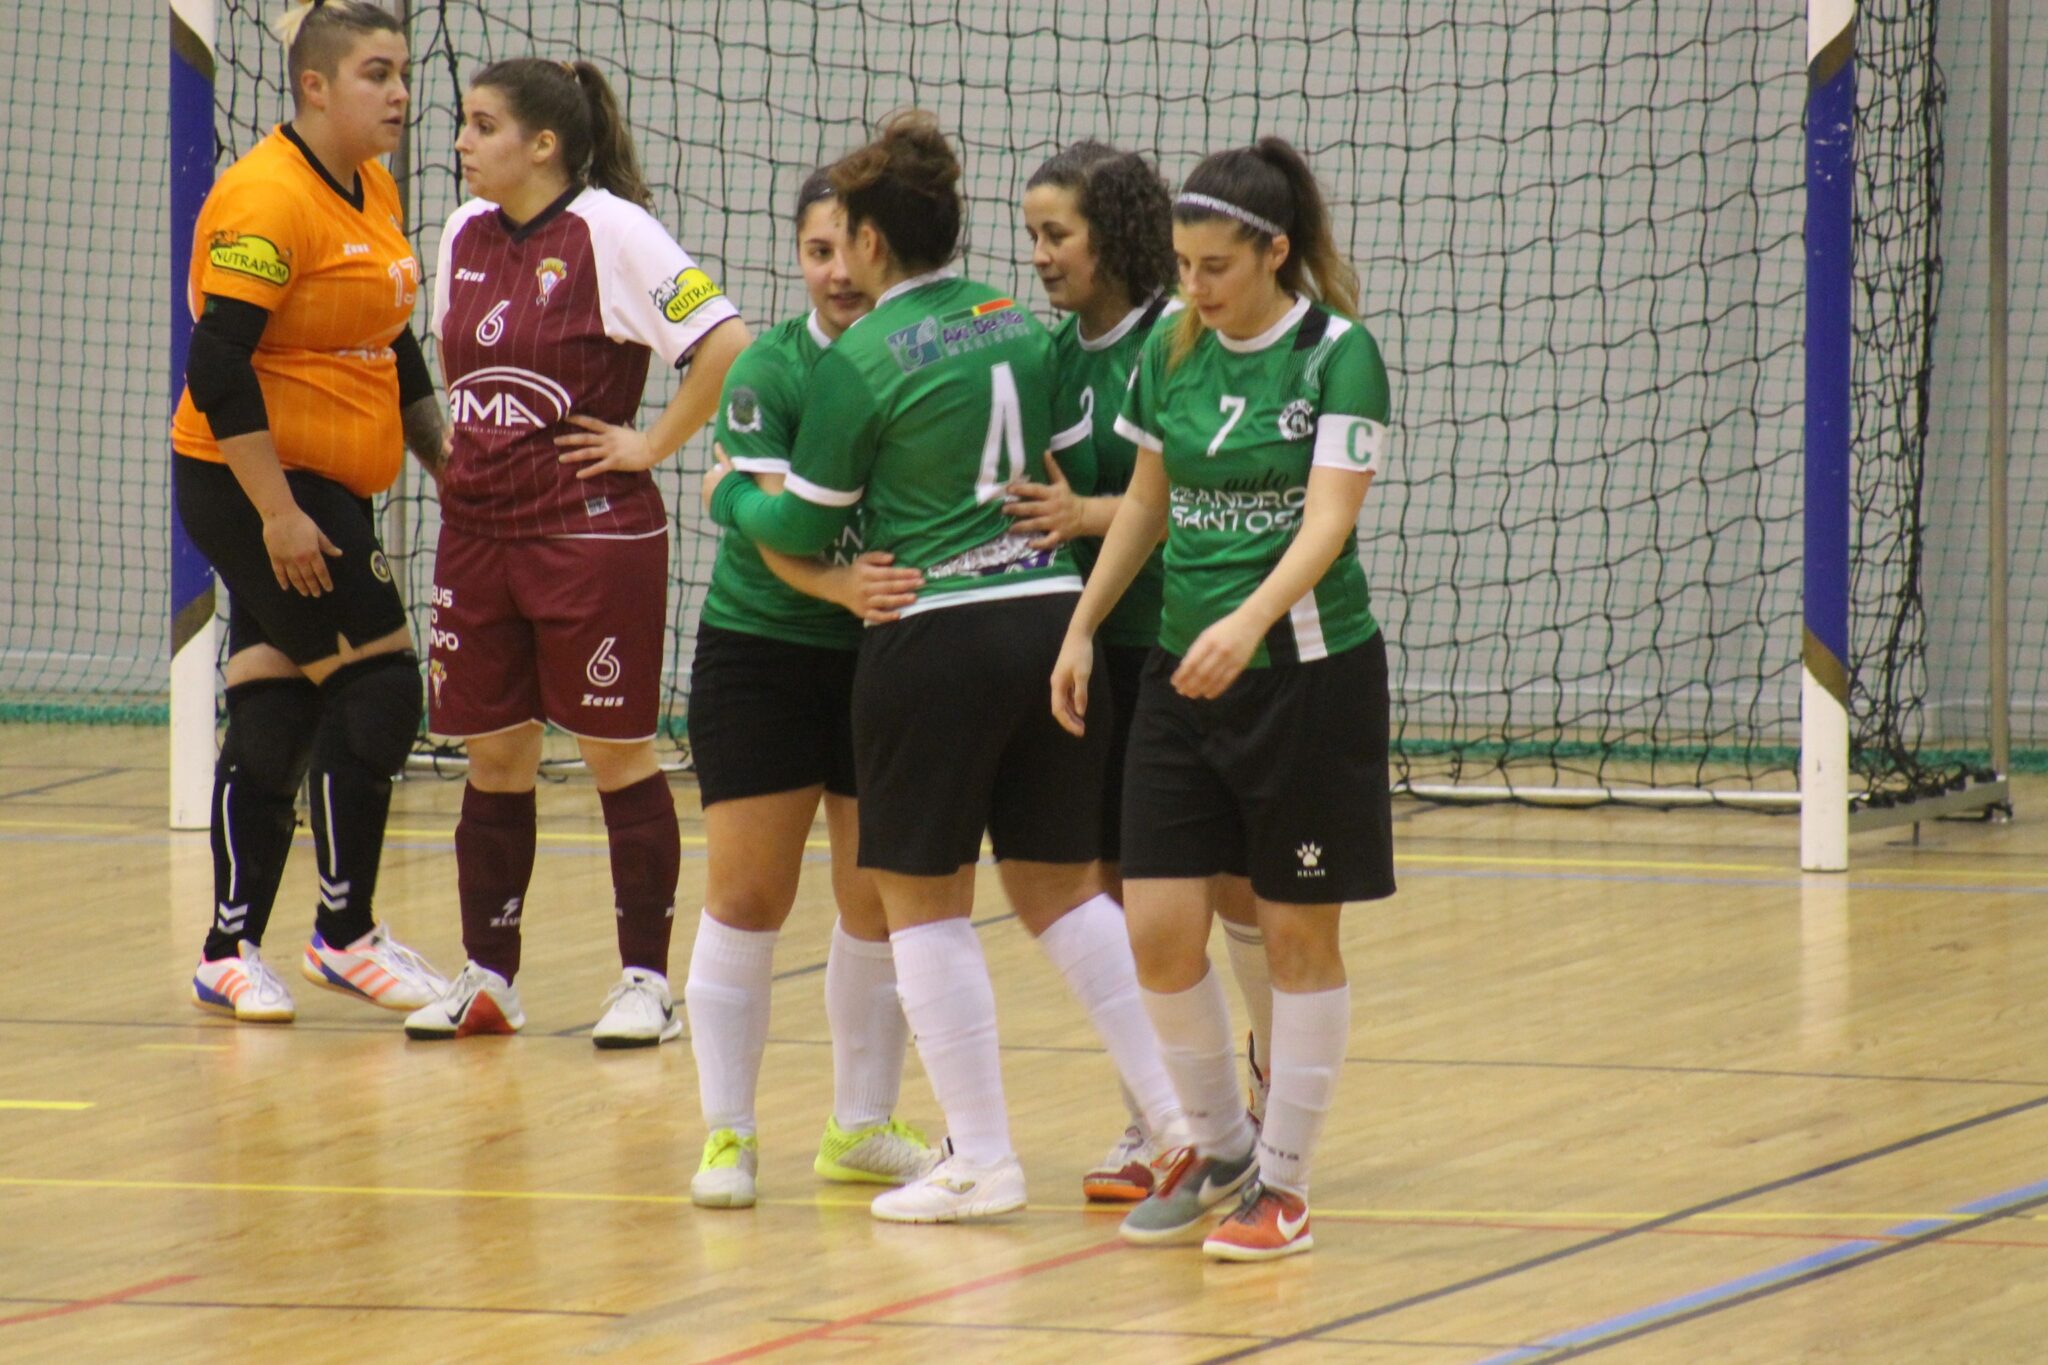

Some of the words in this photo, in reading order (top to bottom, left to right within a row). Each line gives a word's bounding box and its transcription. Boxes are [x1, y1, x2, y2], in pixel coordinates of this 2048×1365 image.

[454, 268, 485, 283] Zeus
[476, 300, 510, 347] 6
[1206, 395, 1246, 457] 7
[1346, 420, 1373, 465] C
[586, 637, 621, 687] 6
[581, 693, 625, 707] Zeus
